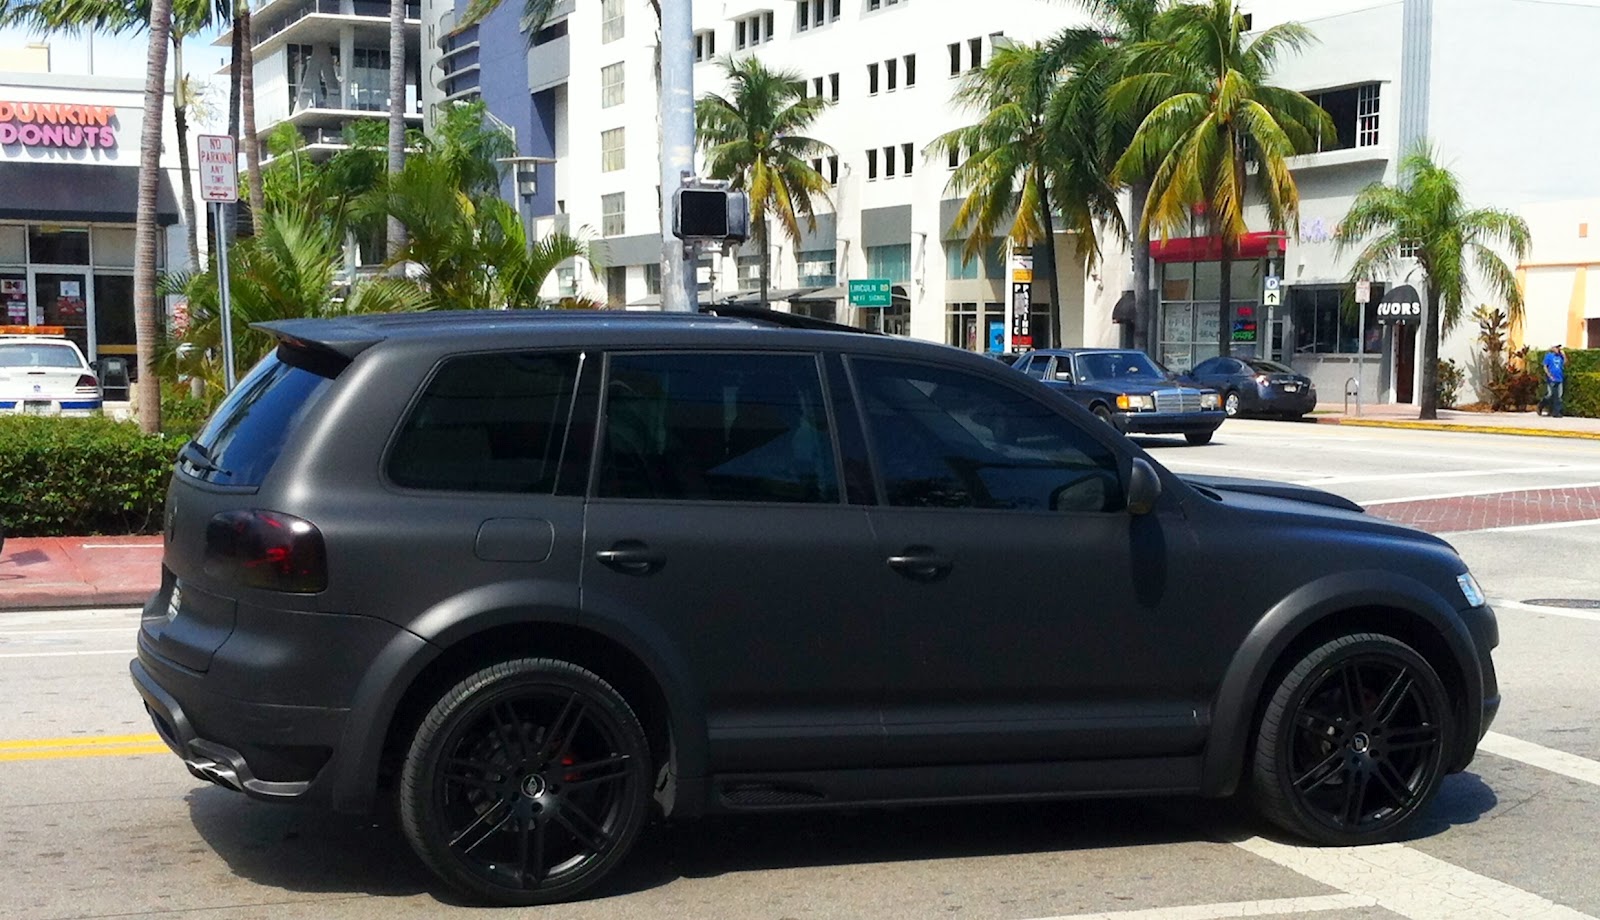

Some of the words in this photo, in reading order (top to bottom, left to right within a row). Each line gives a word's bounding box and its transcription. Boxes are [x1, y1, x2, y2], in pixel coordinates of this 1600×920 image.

[0, 122, 114, 148] DONUTS
[209, 138, 222, 150] NO
[201, 150, 234, 165] PARKING
[210, 165, 224, 174] ANY
[211, 175, 225, 184] TIME
[1022, 284, 1030, 335] PARKING
